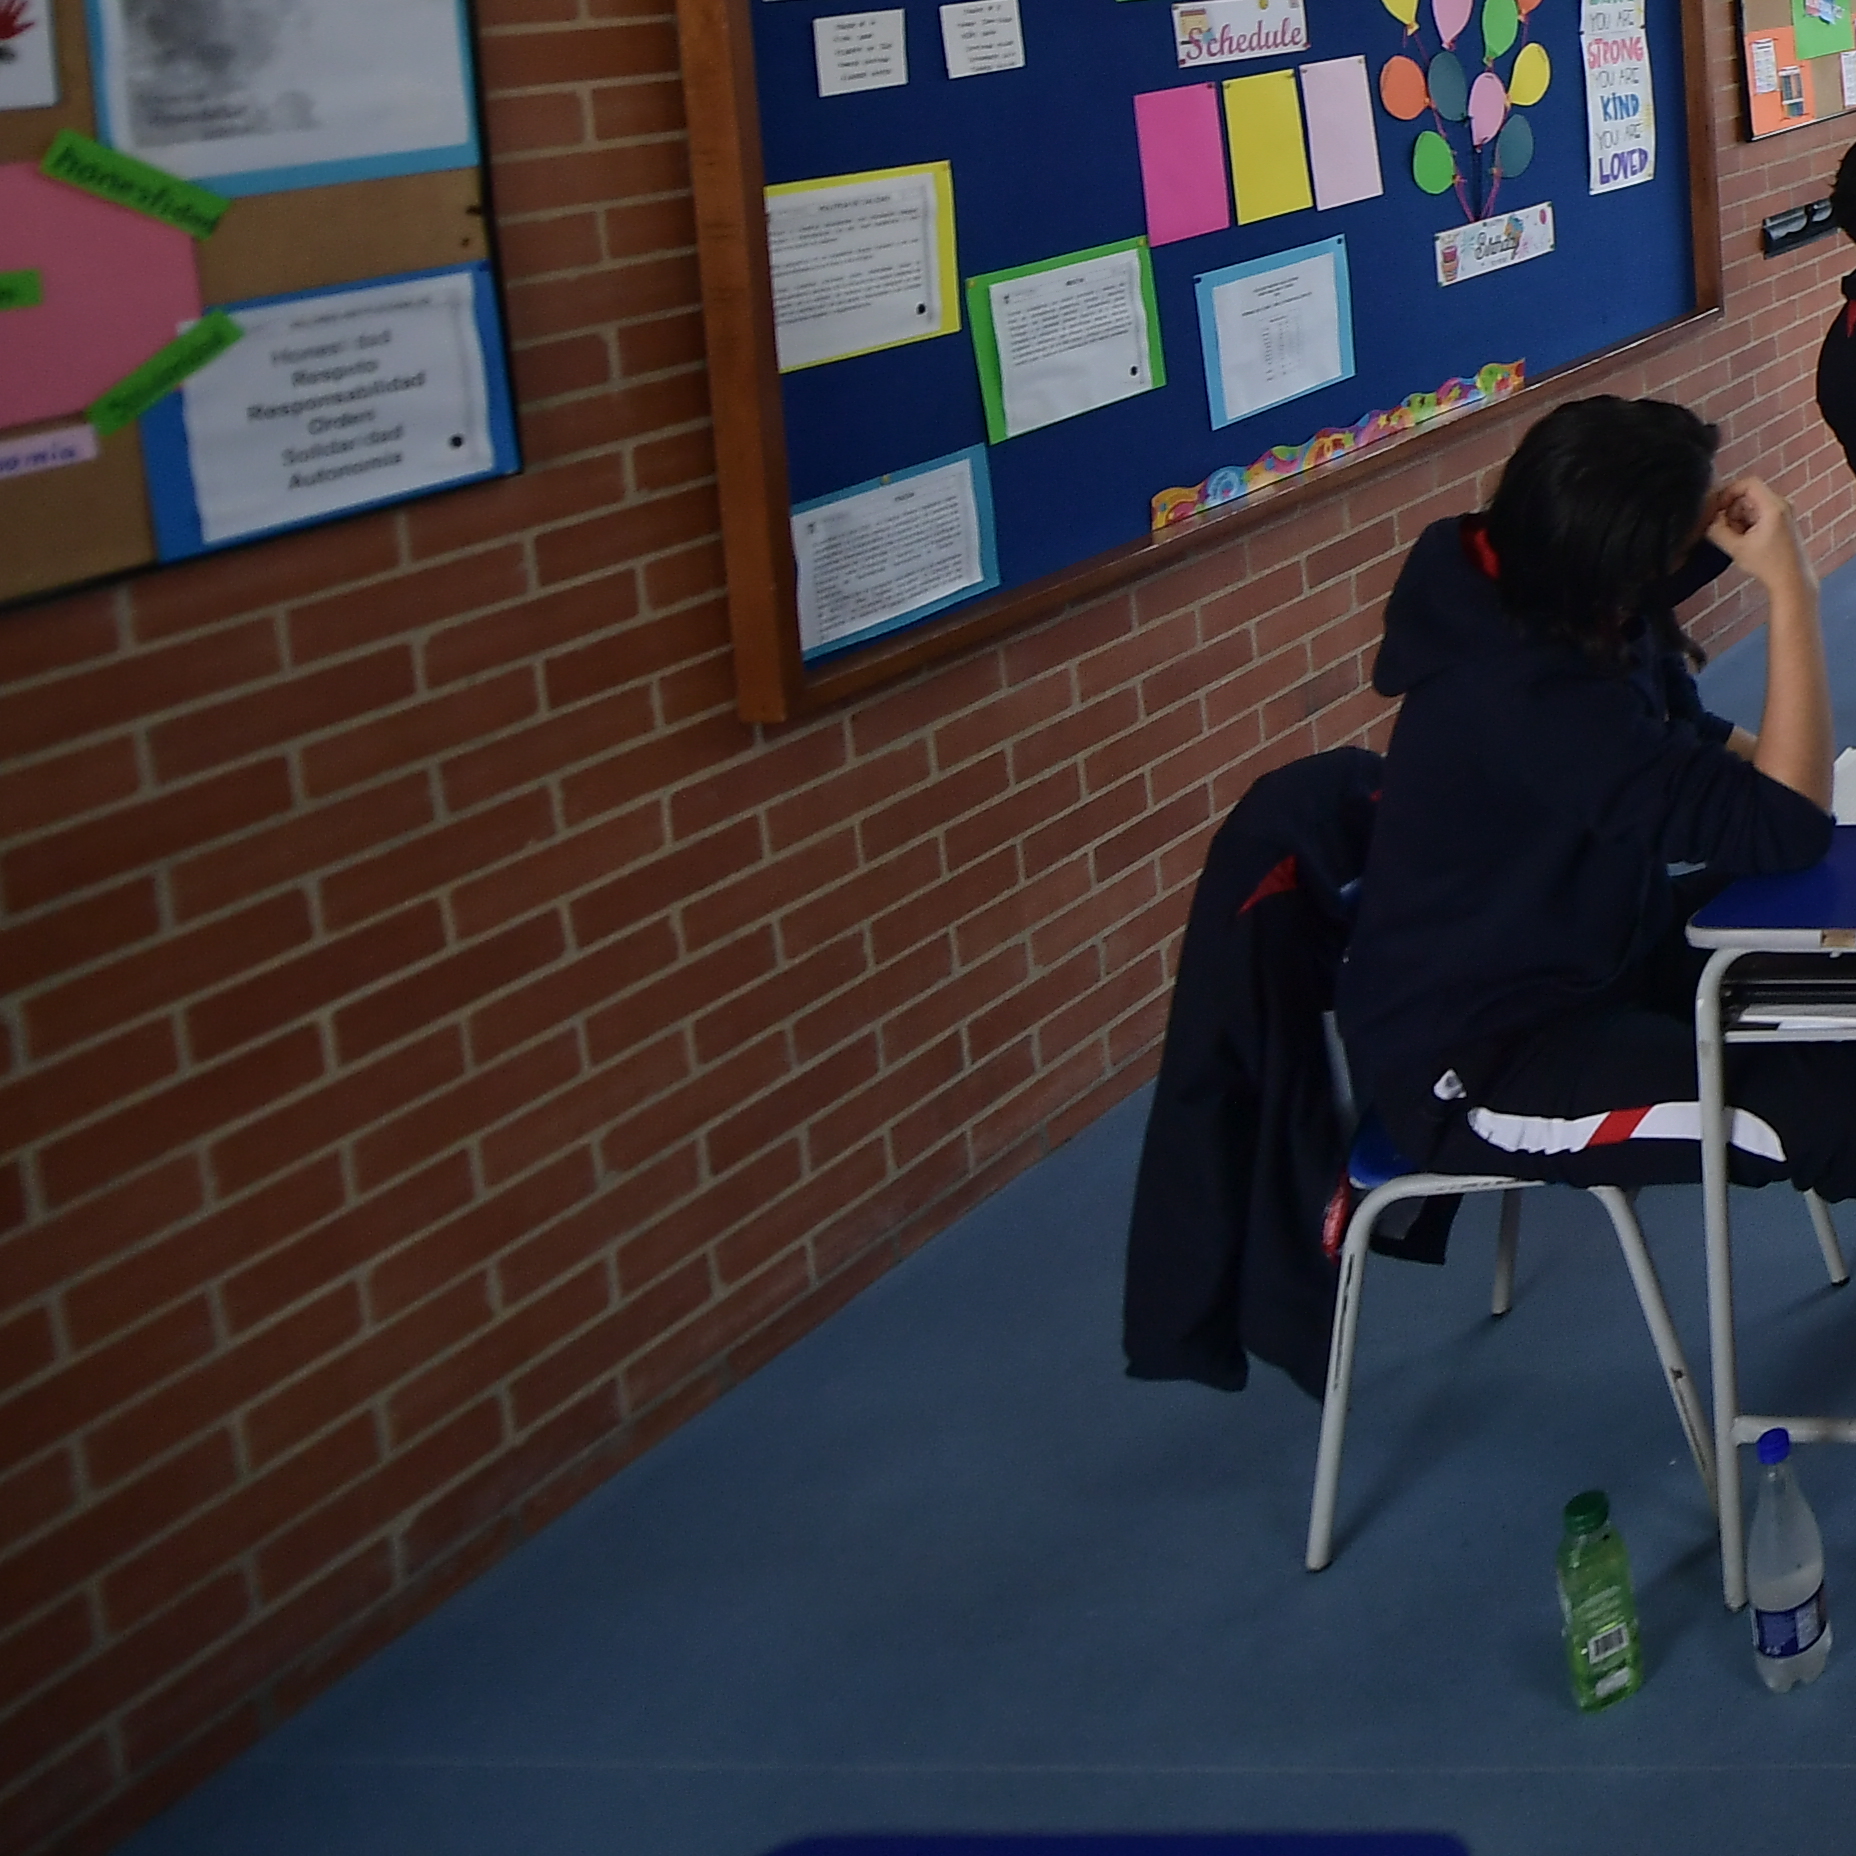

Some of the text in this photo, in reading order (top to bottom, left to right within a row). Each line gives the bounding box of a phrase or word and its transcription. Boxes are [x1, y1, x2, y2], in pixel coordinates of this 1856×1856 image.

[1186, 17, 1301, 60] Schedule
[1587, 36, 1644, 69] STRONG
[1600, 92, 1640, 123] KIND
[1599, 147, 1648, 185] LOVED
